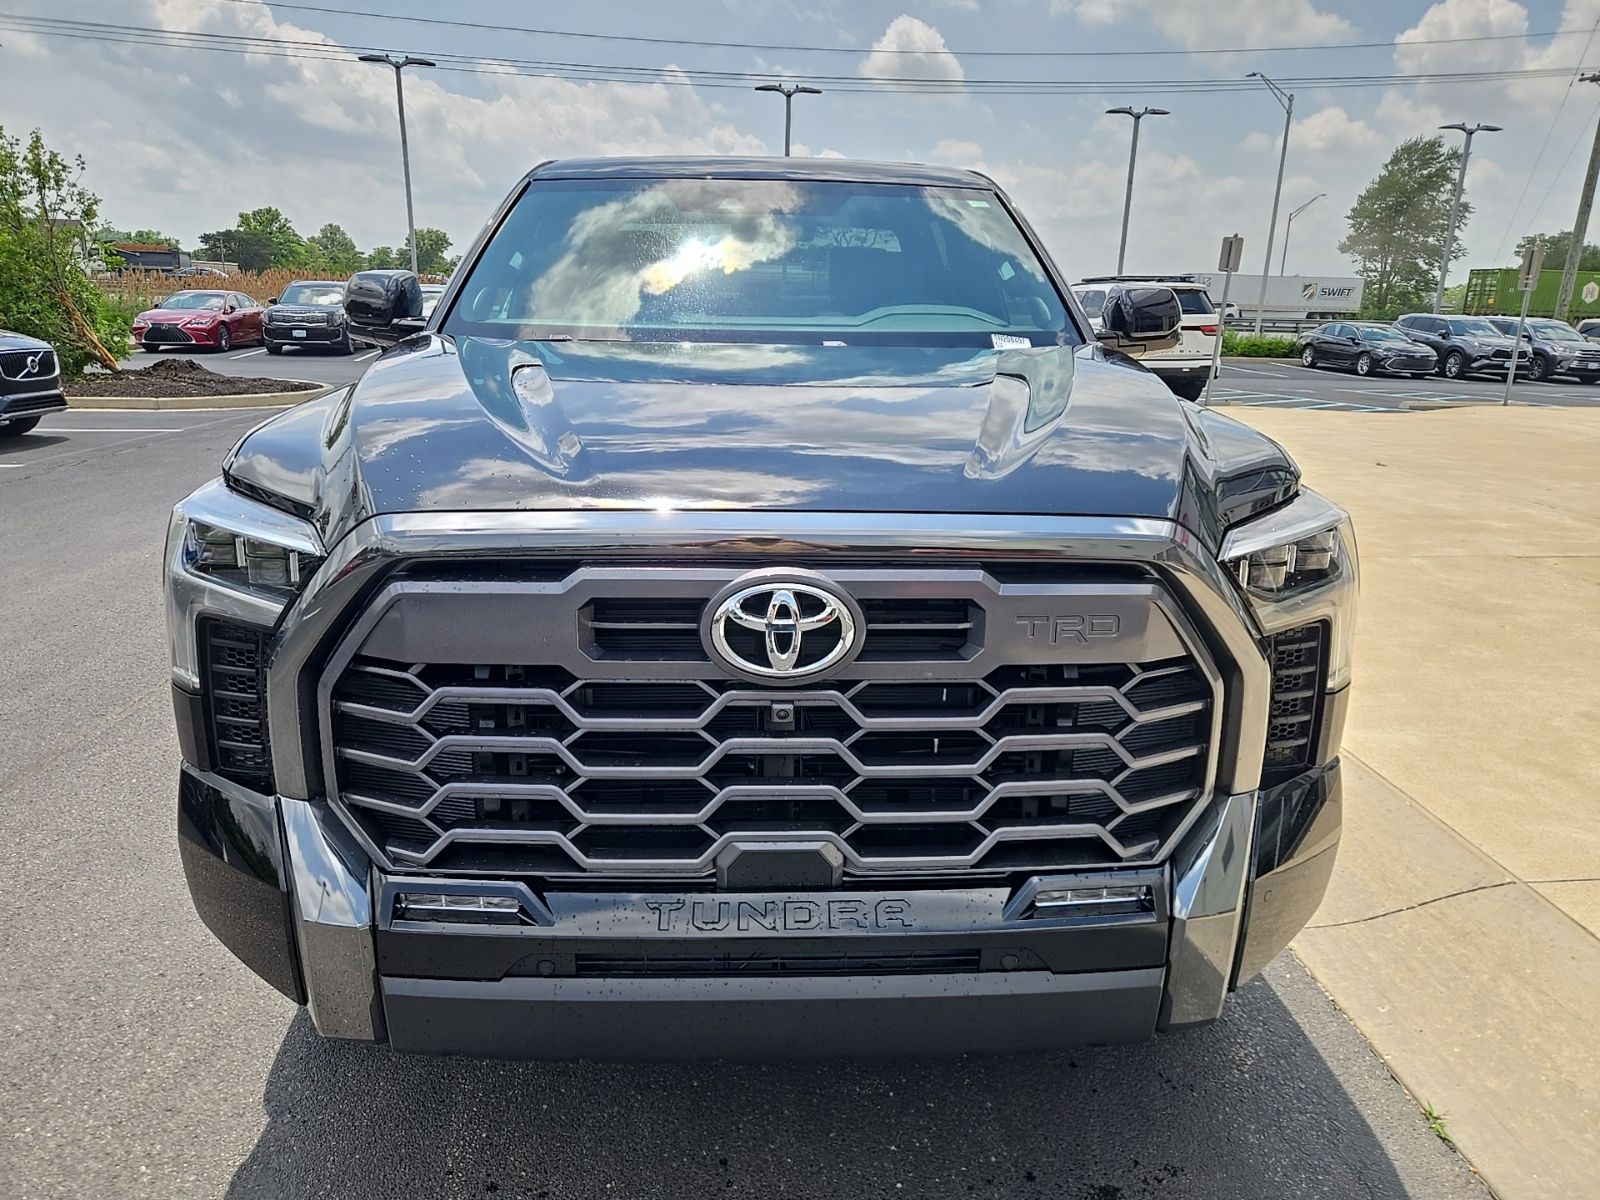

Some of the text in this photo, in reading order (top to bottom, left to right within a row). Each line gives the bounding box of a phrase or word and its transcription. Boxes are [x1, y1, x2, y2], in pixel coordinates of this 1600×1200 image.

[1320, 287, 1354, 297] SWIFT
[1015, 614, 1121, 646] TRD
[645, 898, 913, 931] TUNDRA
